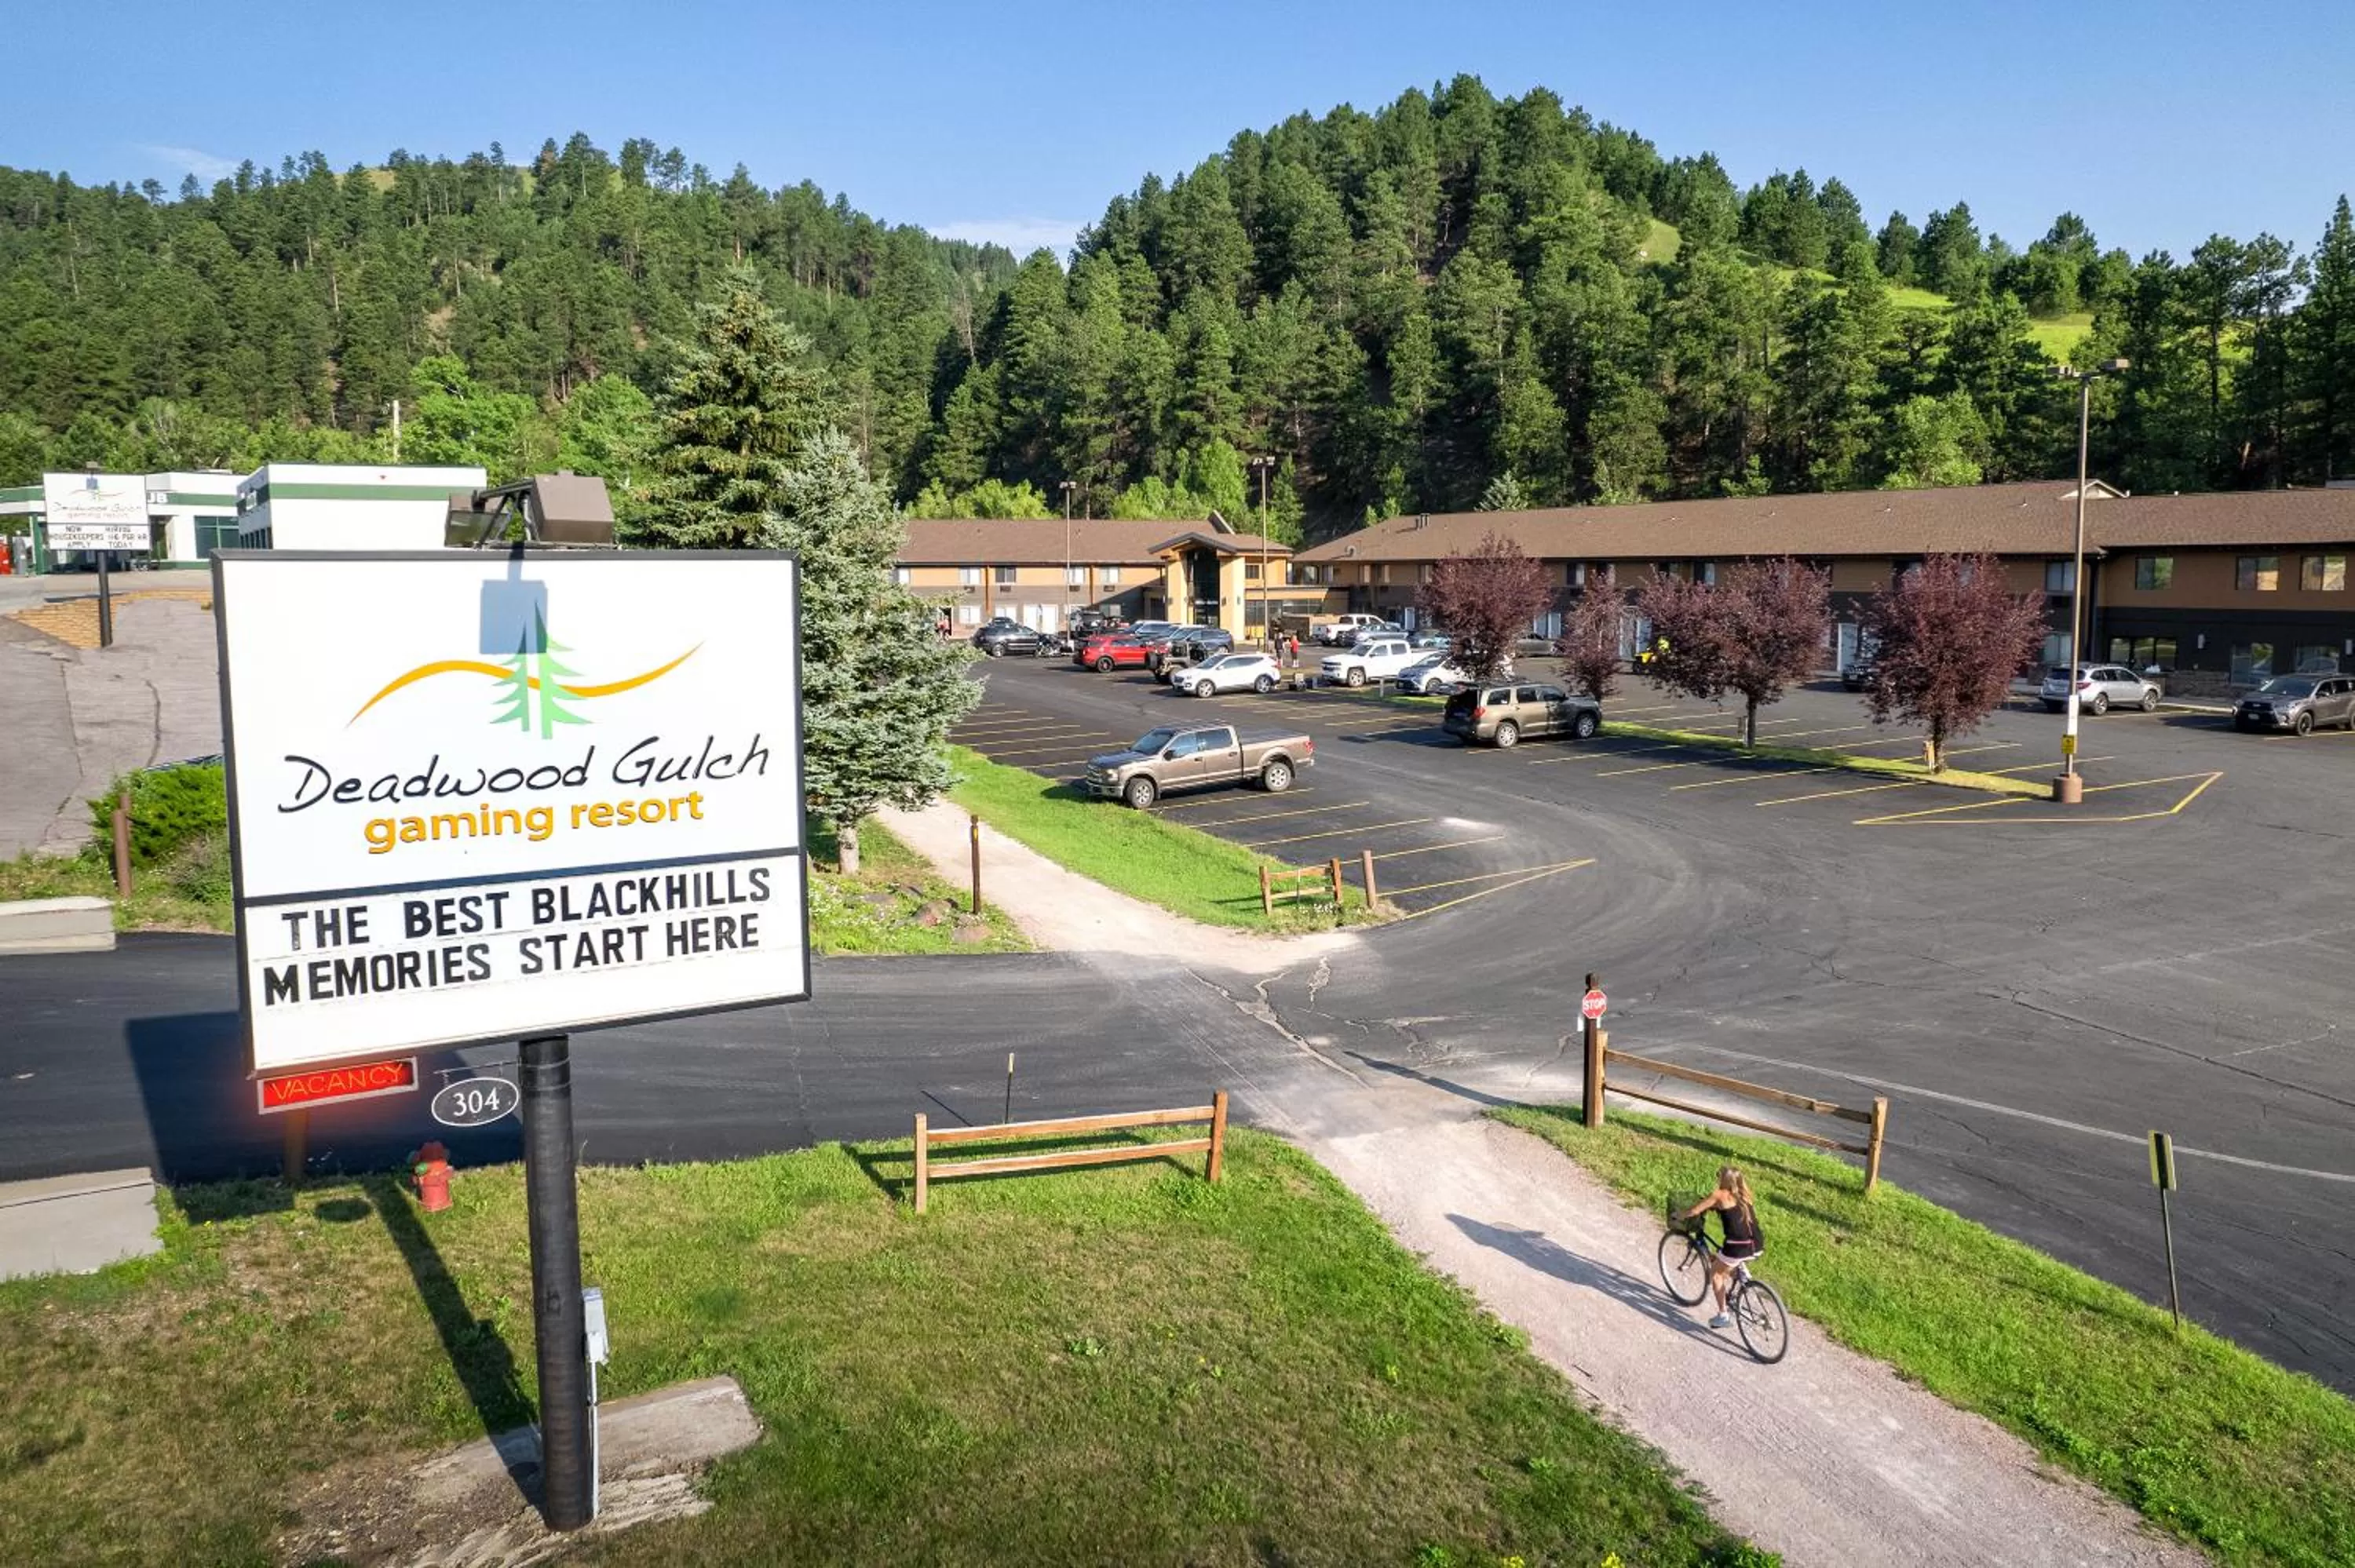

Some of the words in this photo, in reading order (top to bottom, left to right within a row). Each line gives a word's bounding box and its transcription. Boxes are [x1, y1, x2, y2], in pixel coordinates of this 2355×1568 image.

[277, 745, 596, 814] Deadwood
[612, 732, 770, 788] Gulch
[363, 803, 553, 855] gaming
[570, 790, 705, 830] resort
[281, 905, 371, 951] THE
[403, 891, 509, 939] BEST
[531, 866, 771, 925] BLACKHILLS
[263, 943, 491, 1006] MEMORIES
[519, 924, 649, 975] START
[666, 912, 759, 957] HERE
[1583, 998, 1605, 1010] STOP
[268, 1063, 404, 1100] VACANCY
[452, 1086, 500, 1118] 304
